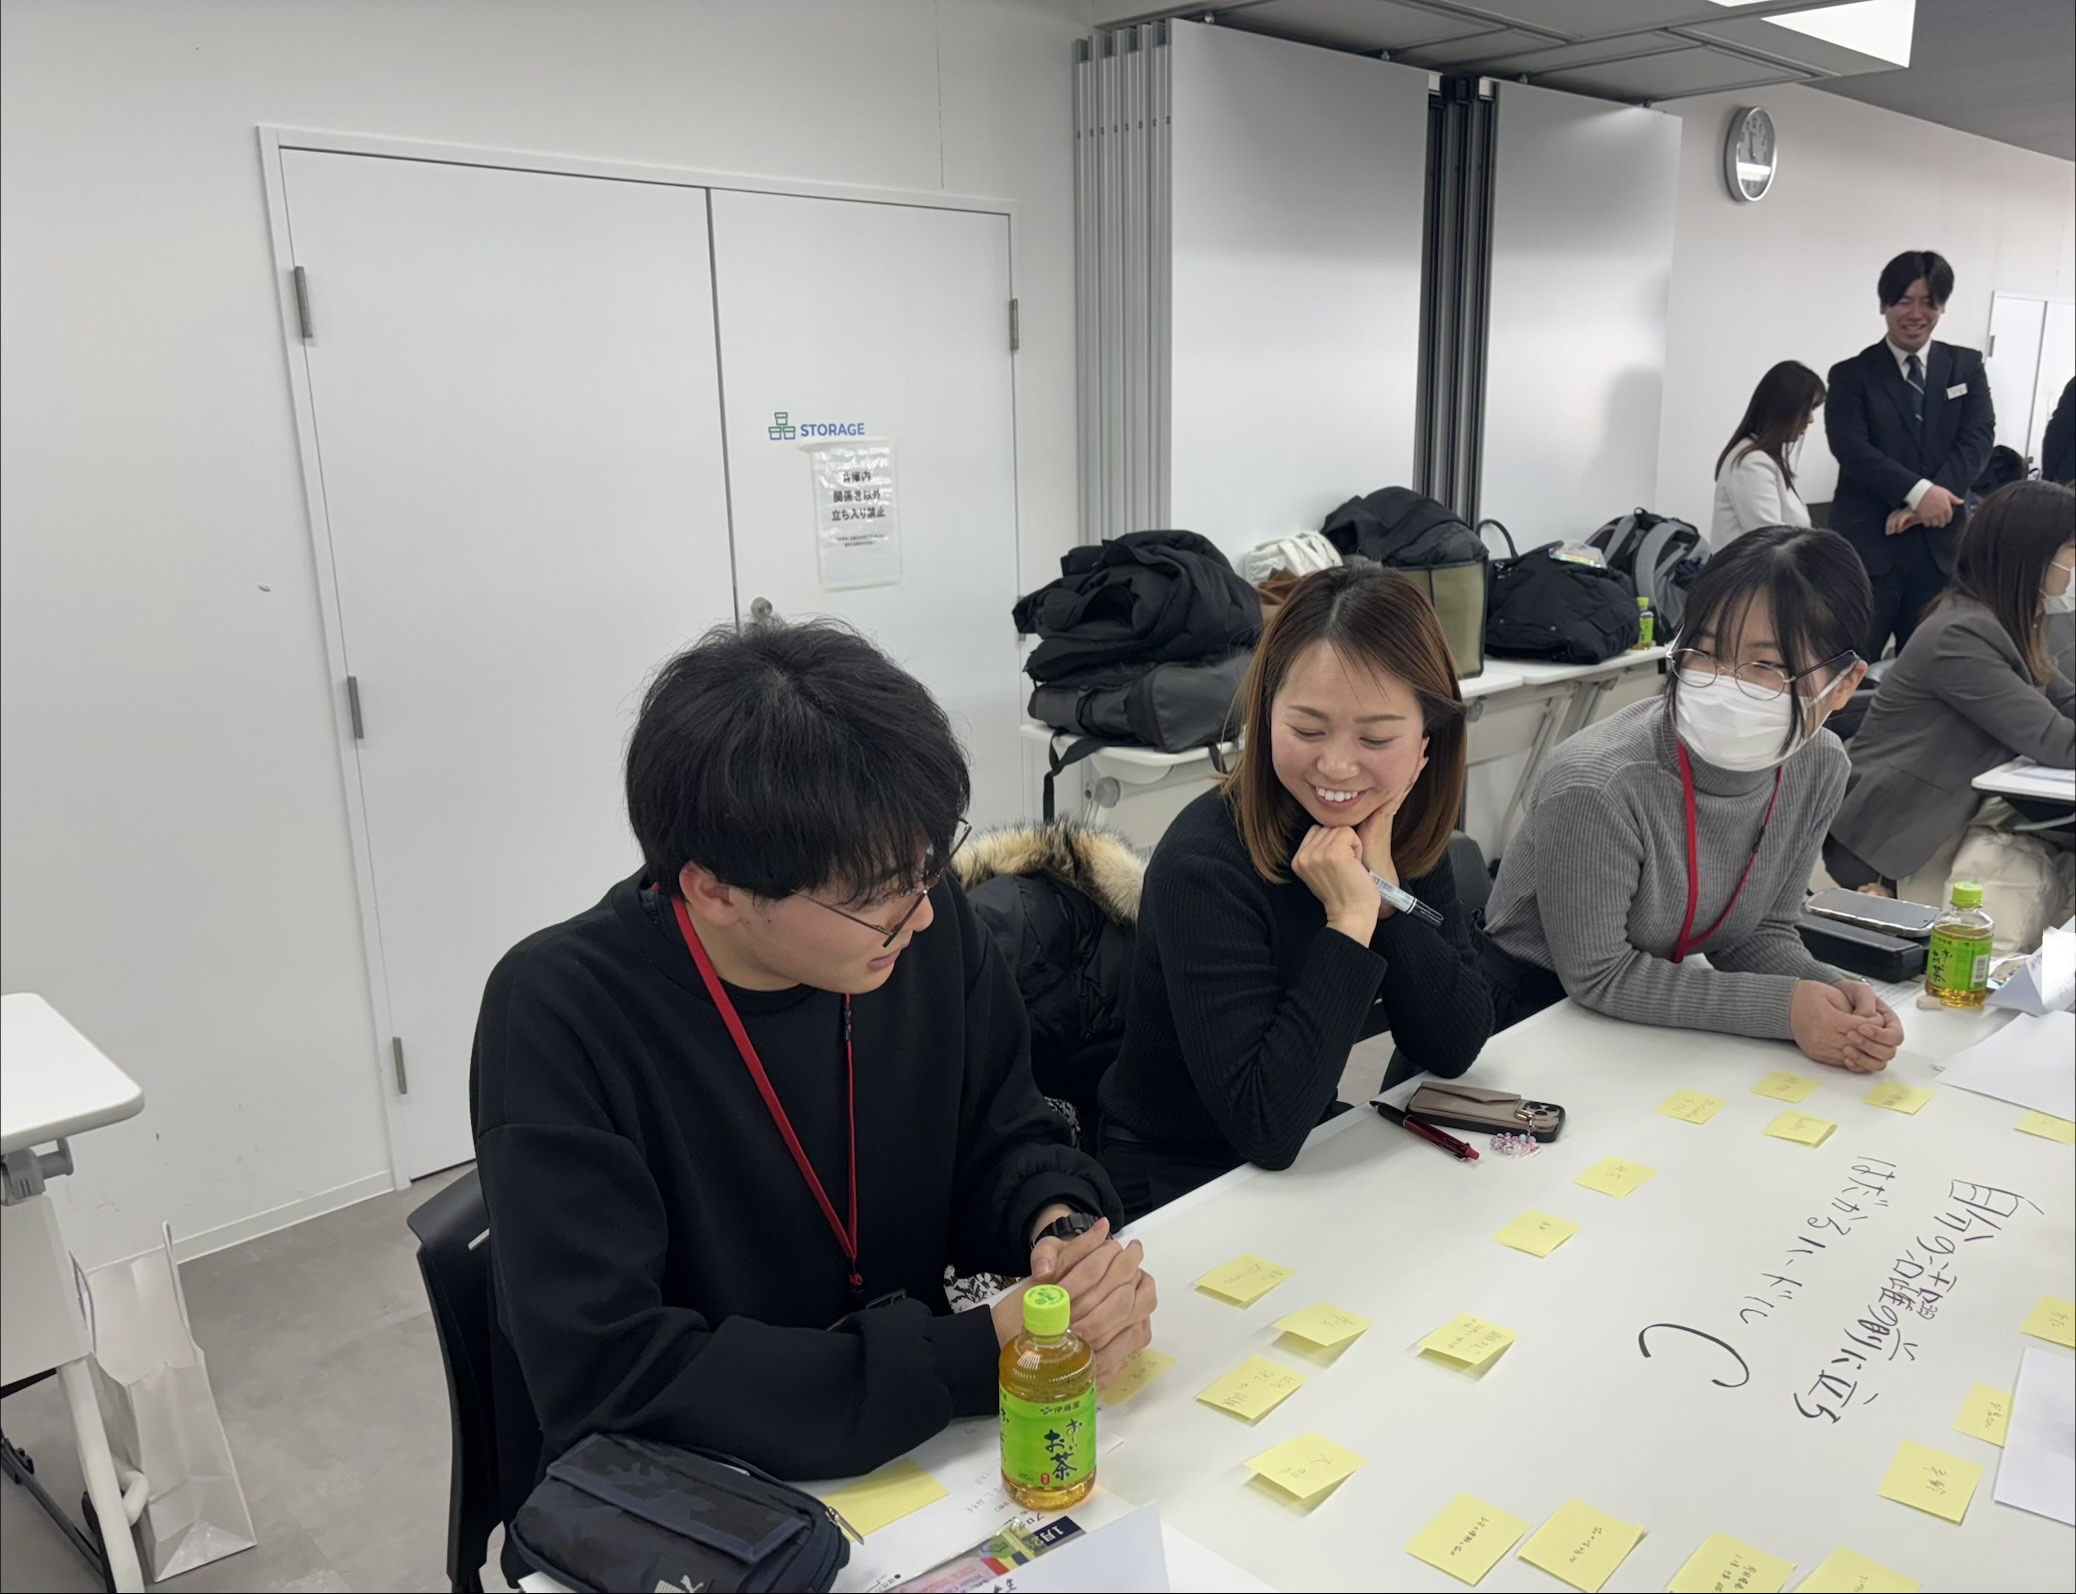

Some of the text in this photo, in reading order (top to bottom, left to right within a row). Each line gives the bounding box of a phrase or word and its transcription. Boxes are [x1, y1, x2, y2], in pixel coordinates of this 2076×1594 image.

[801, 423, 865, 437] STORAGE
[832, 506, 886, 521] 立ち入り禁止
[1052, 1401, 1081, 1414] 伊藤園
[1043, 1428, 1078, 1481] お茶
